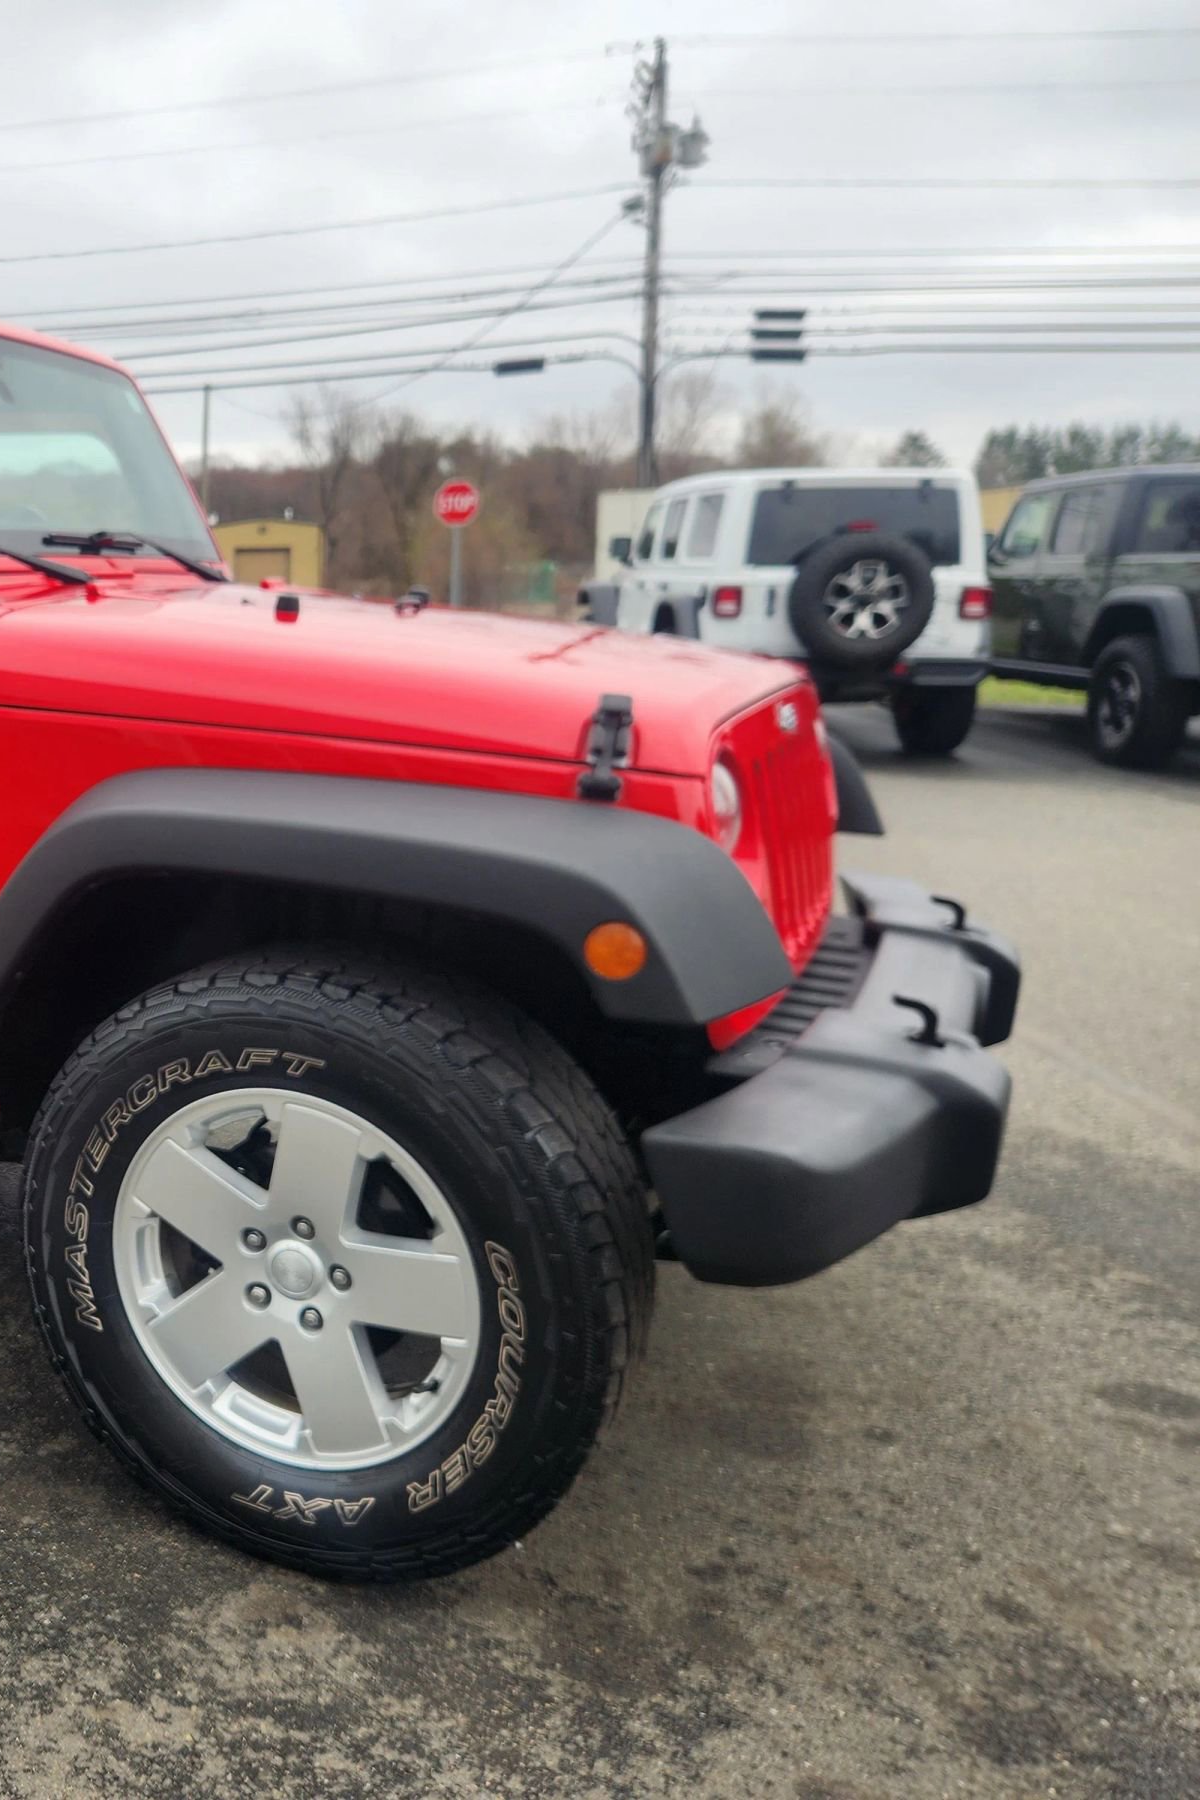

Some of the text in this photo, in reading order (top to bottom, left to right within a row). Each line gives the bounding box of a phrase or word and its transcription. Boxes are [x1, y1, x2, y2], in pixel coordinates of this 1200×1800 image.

[438, 493, 478, 513] STOP
[63, 1047, 326, 1331] MASTERCRAFT
[232, 1239, 527, 1526] COURSER AXT
